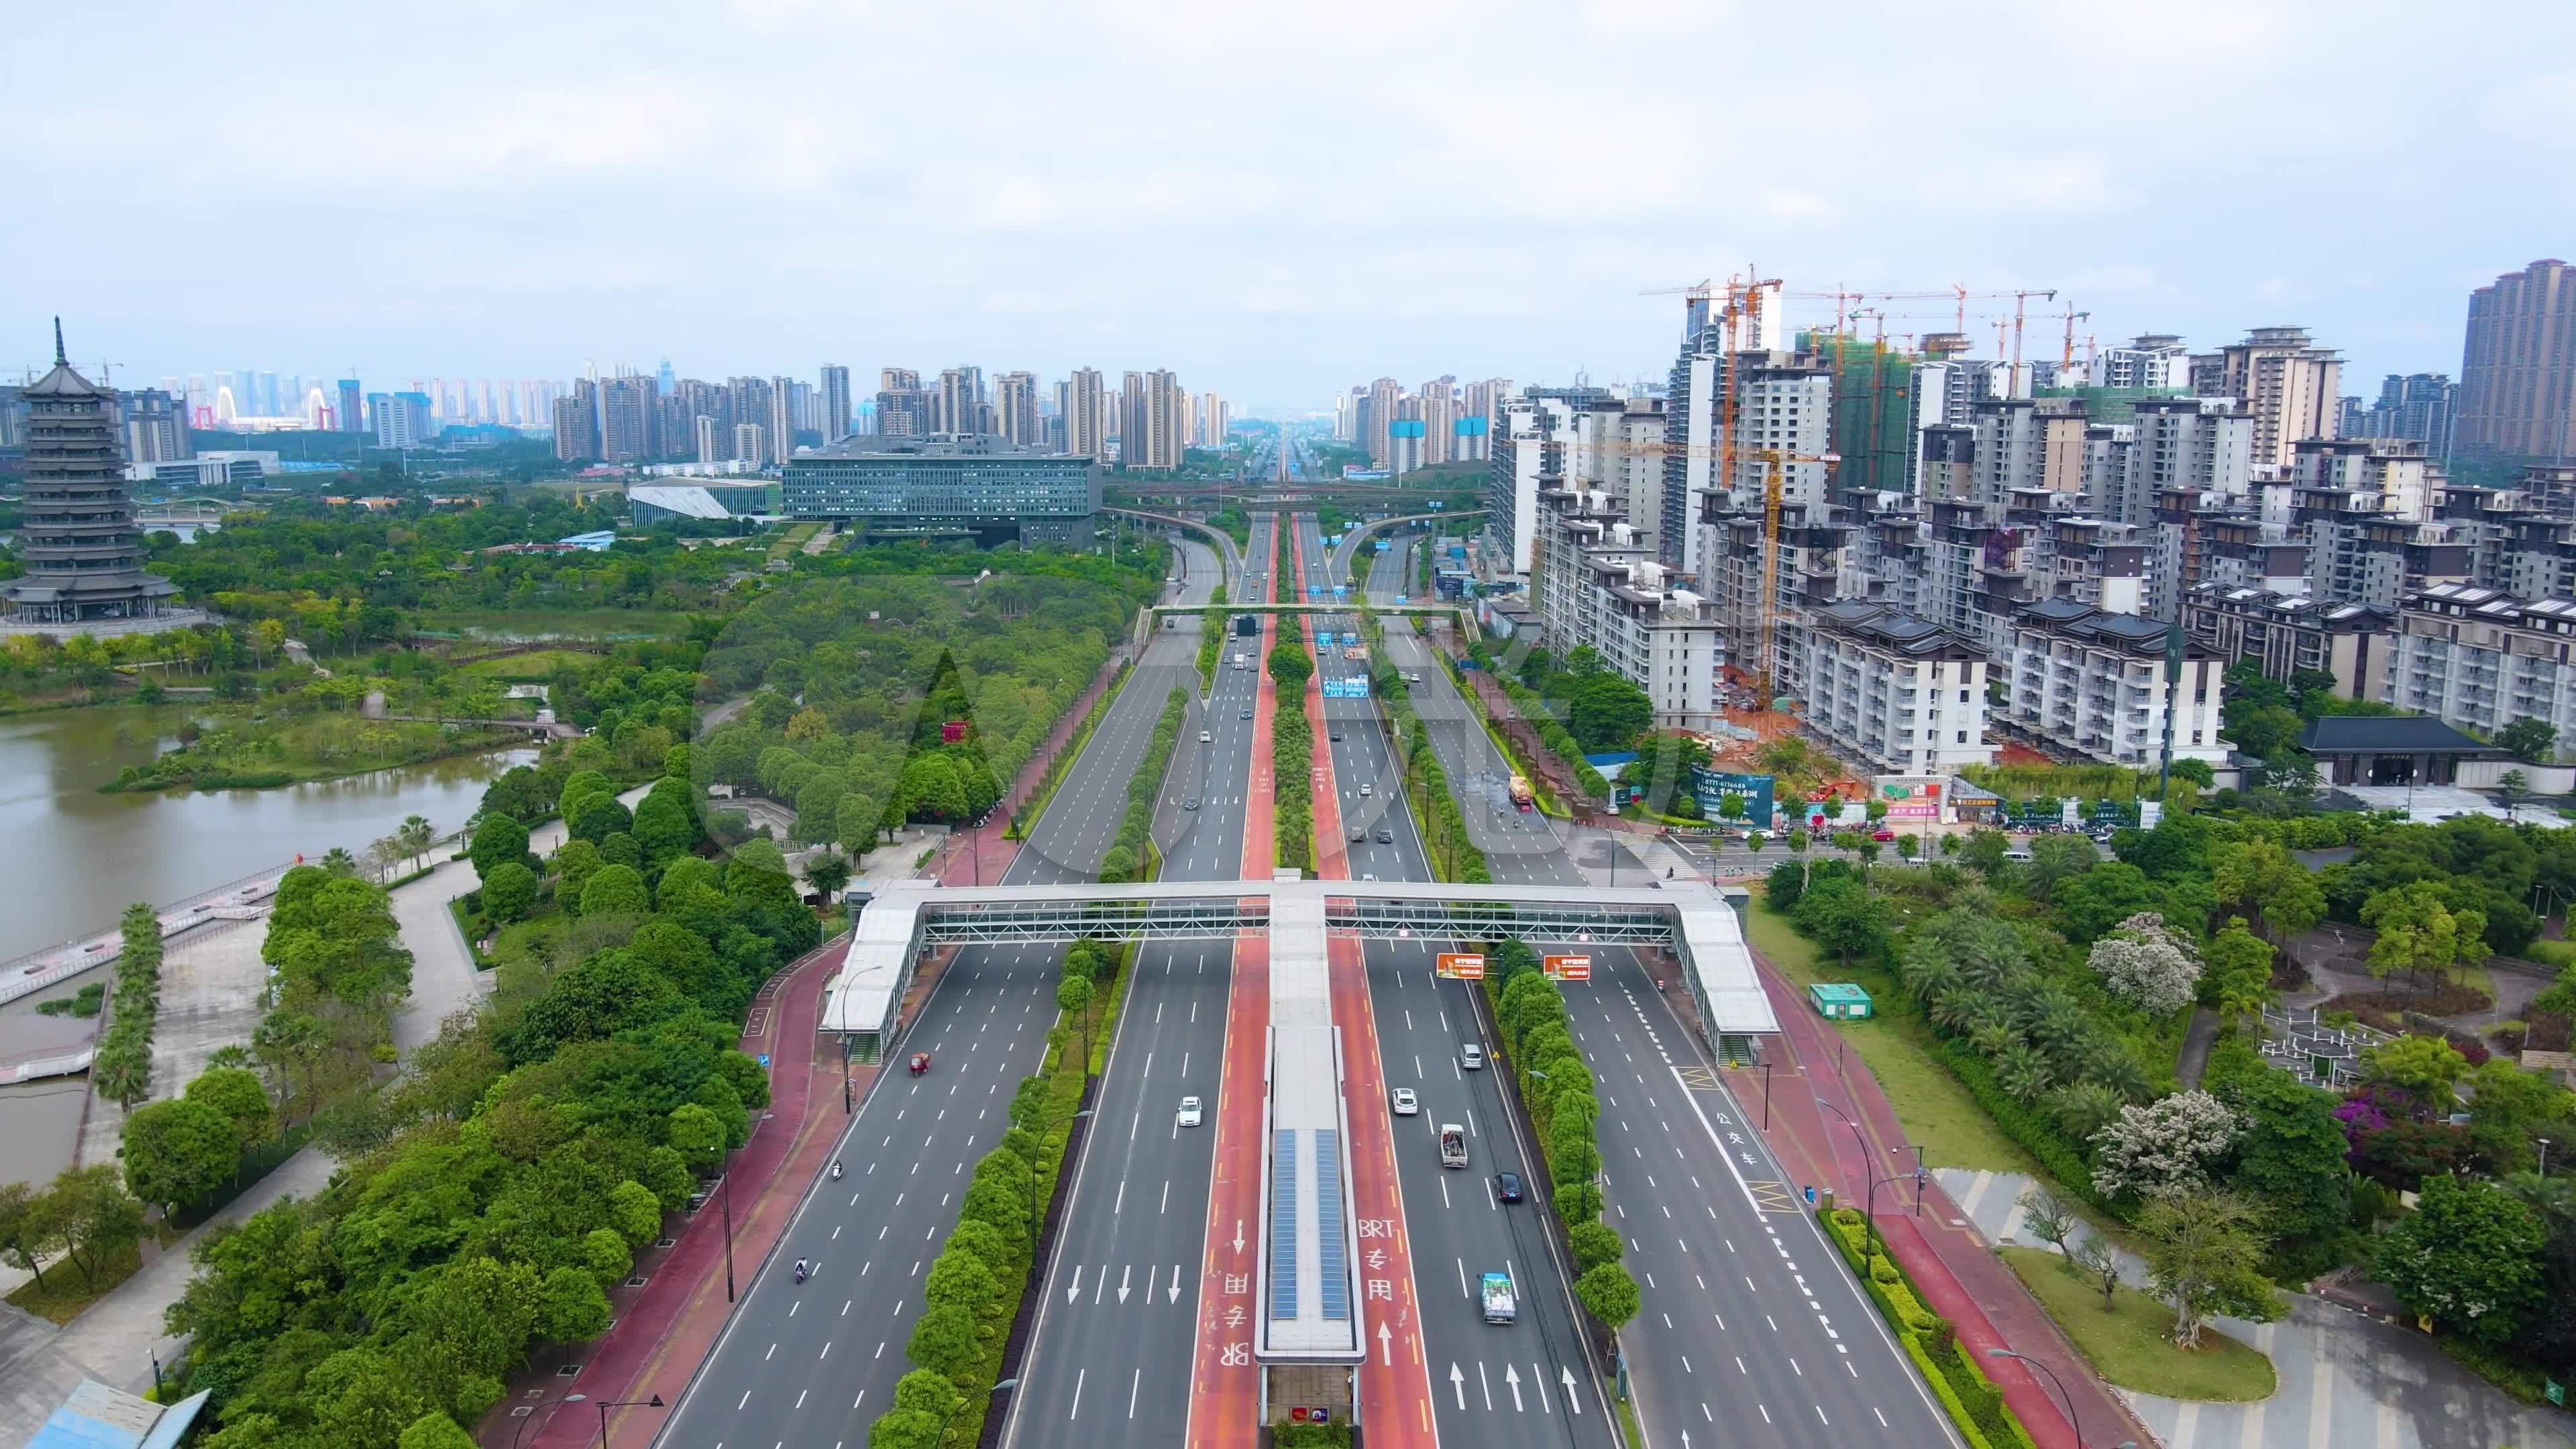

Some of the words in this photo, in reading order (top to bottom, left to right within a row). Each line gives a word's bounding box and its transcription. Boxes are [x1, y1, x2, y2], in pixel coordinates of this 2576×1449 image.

[1717, 1112, 1758, 1165] 公交车
[1358, 1219, 1395, 1238] BRT
[1364, 1248, 1393, 1301] 专用
